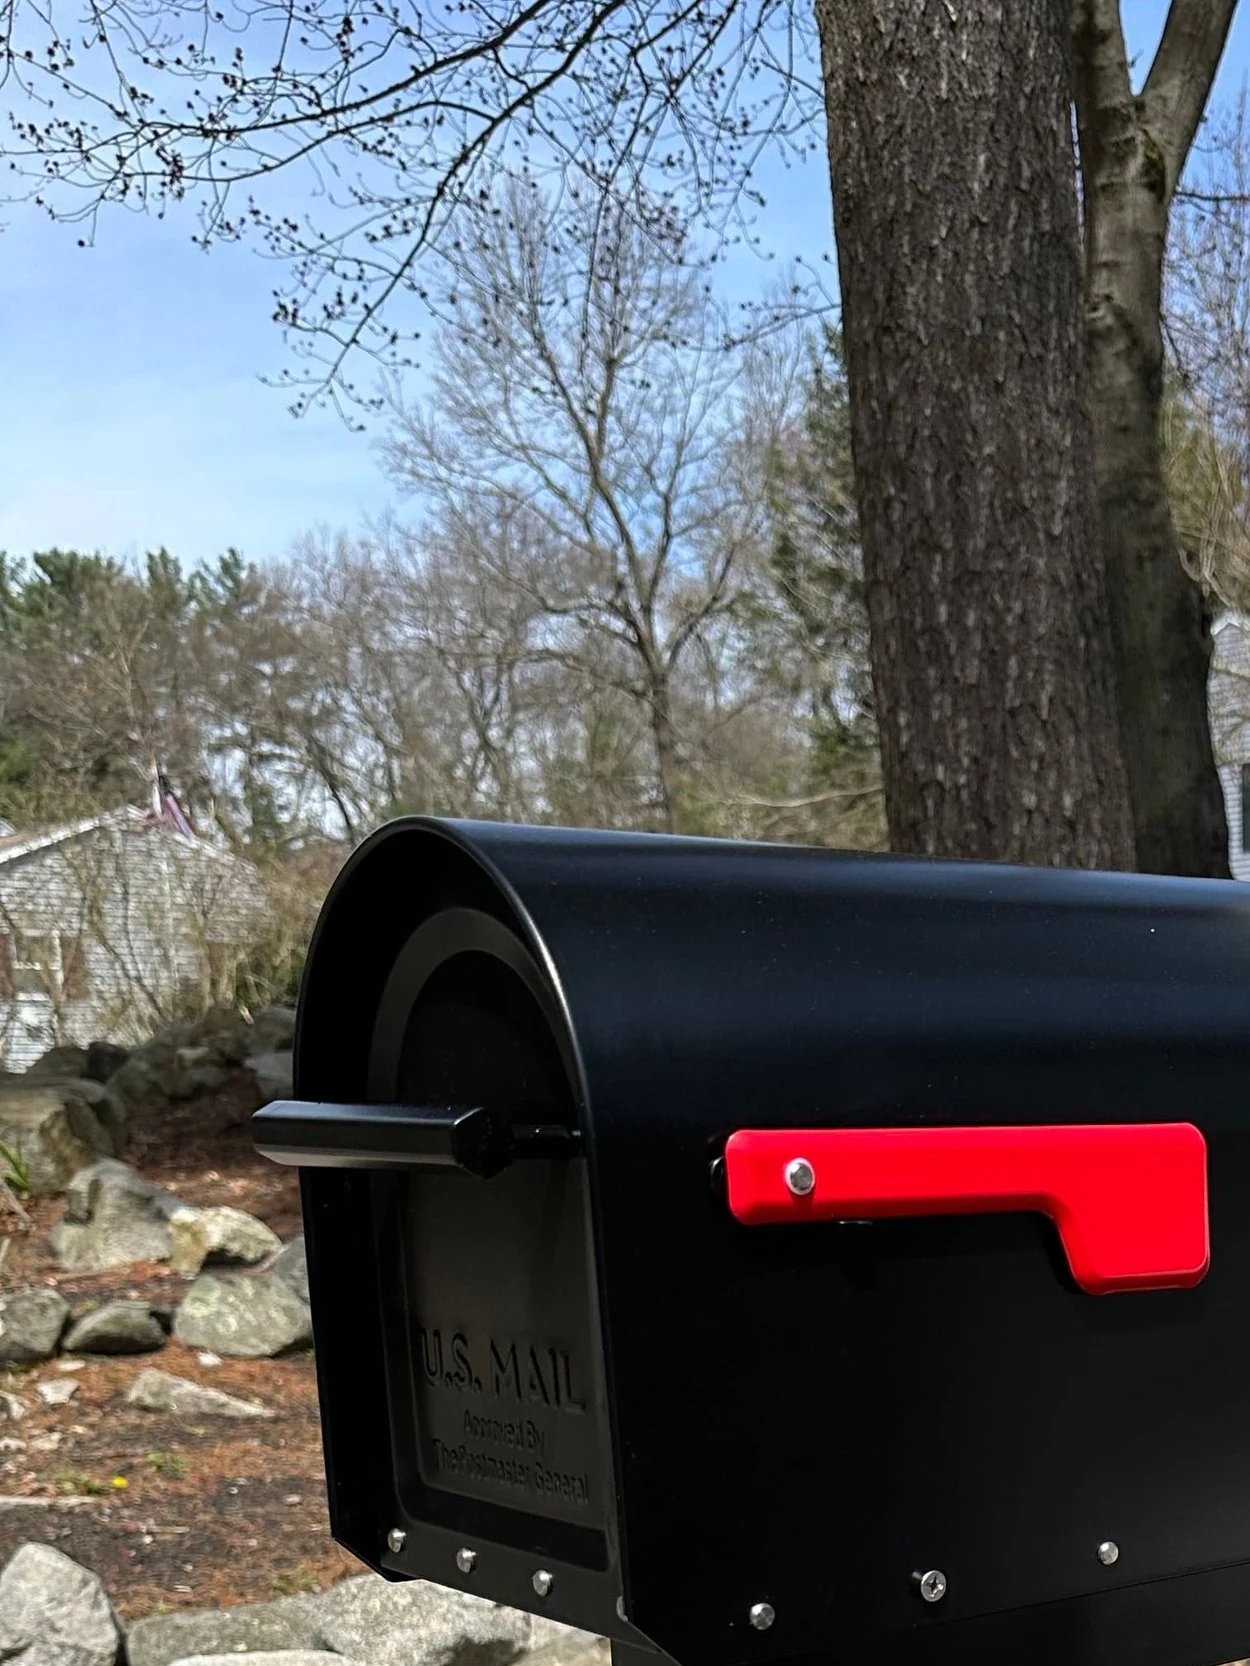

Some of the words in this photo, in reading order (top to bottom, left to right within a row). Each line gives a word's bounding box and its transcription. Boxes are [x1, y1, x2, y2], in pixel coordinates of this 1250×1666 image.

[421, 1328, 482, 1394] U.S.
[490, 1339, 586, 1415] MAIL
[526, 1420, 545, 1460] By
